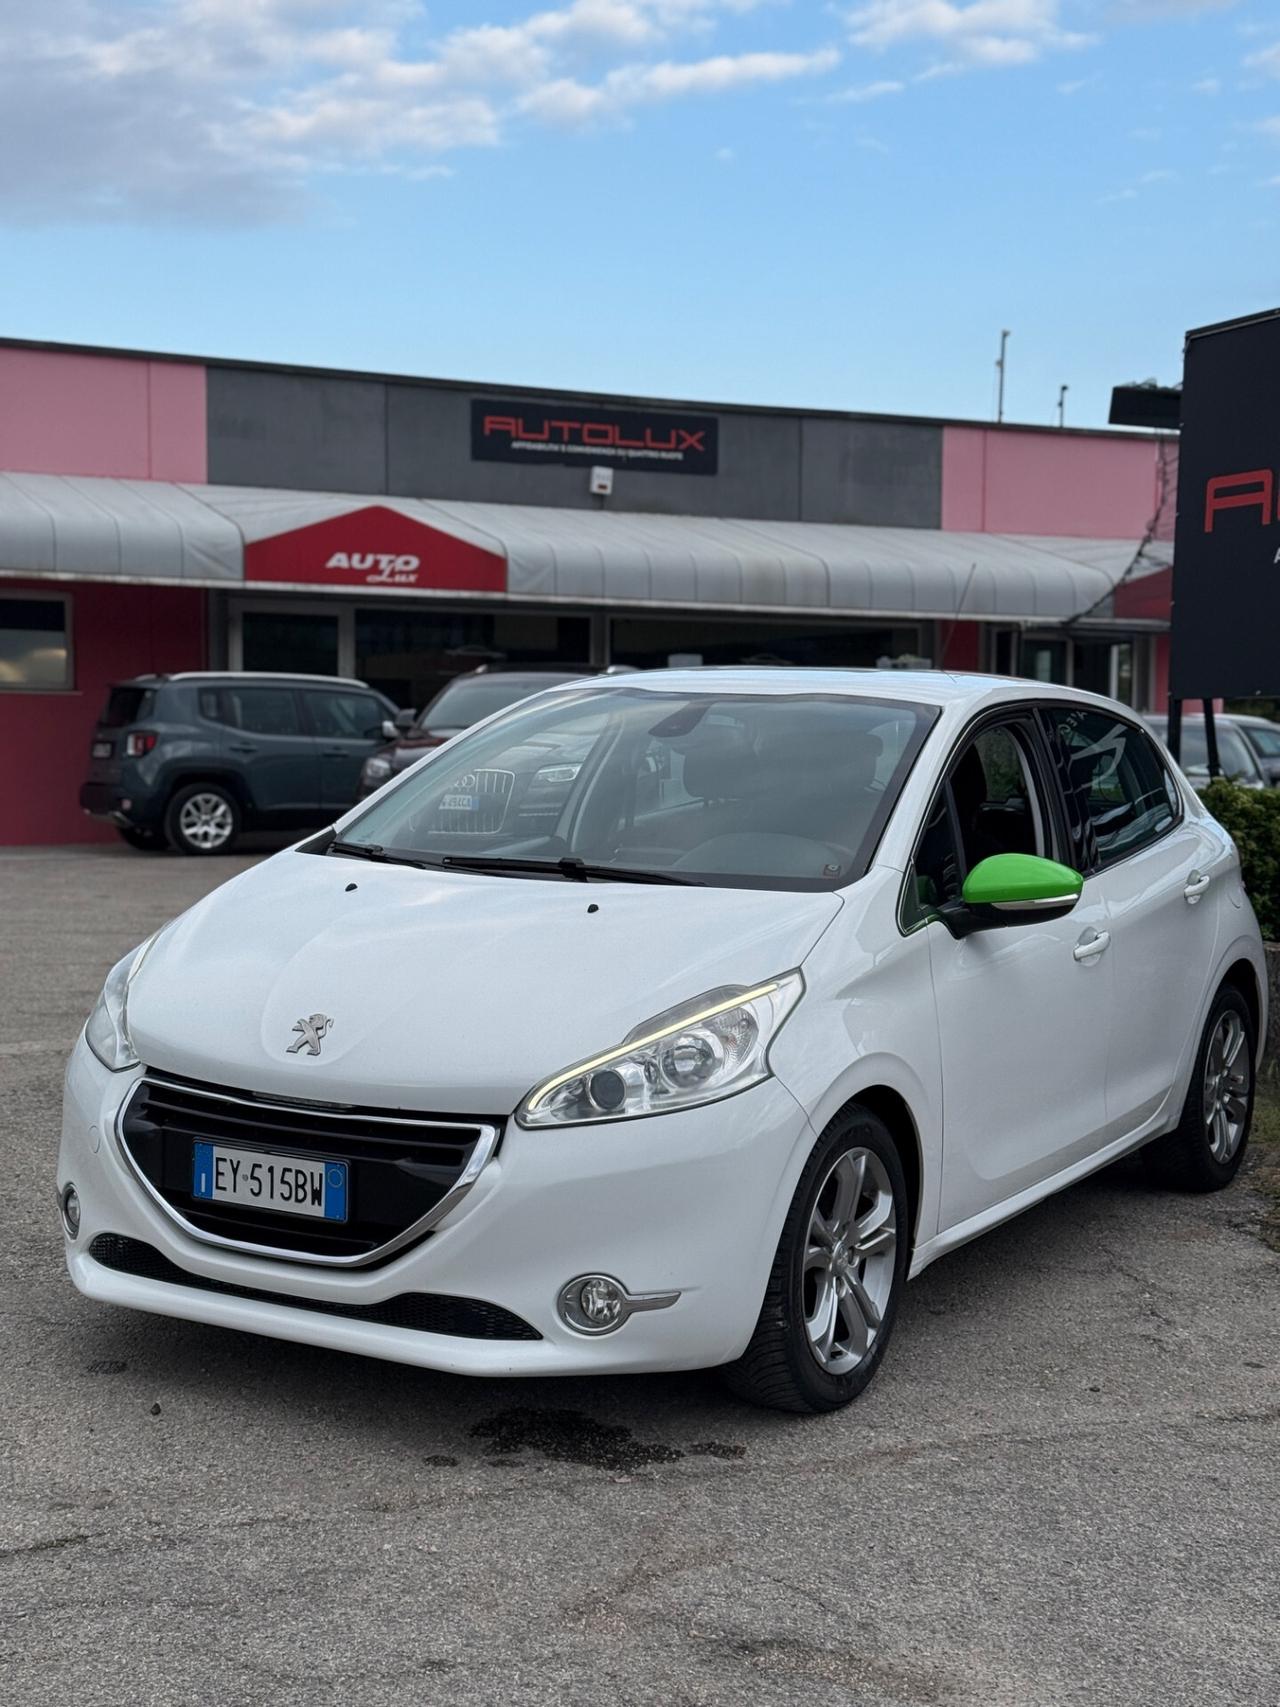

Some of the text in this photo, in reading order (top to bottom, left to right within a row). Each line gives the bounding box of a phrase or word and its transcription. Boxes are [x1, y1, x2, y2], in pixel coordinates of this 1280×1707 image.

[483, 415, 705, 451] AUTOLUX
[325, 552, 420, 572] AUTO
[215, 1156, 323, 1207] EY 515BW
